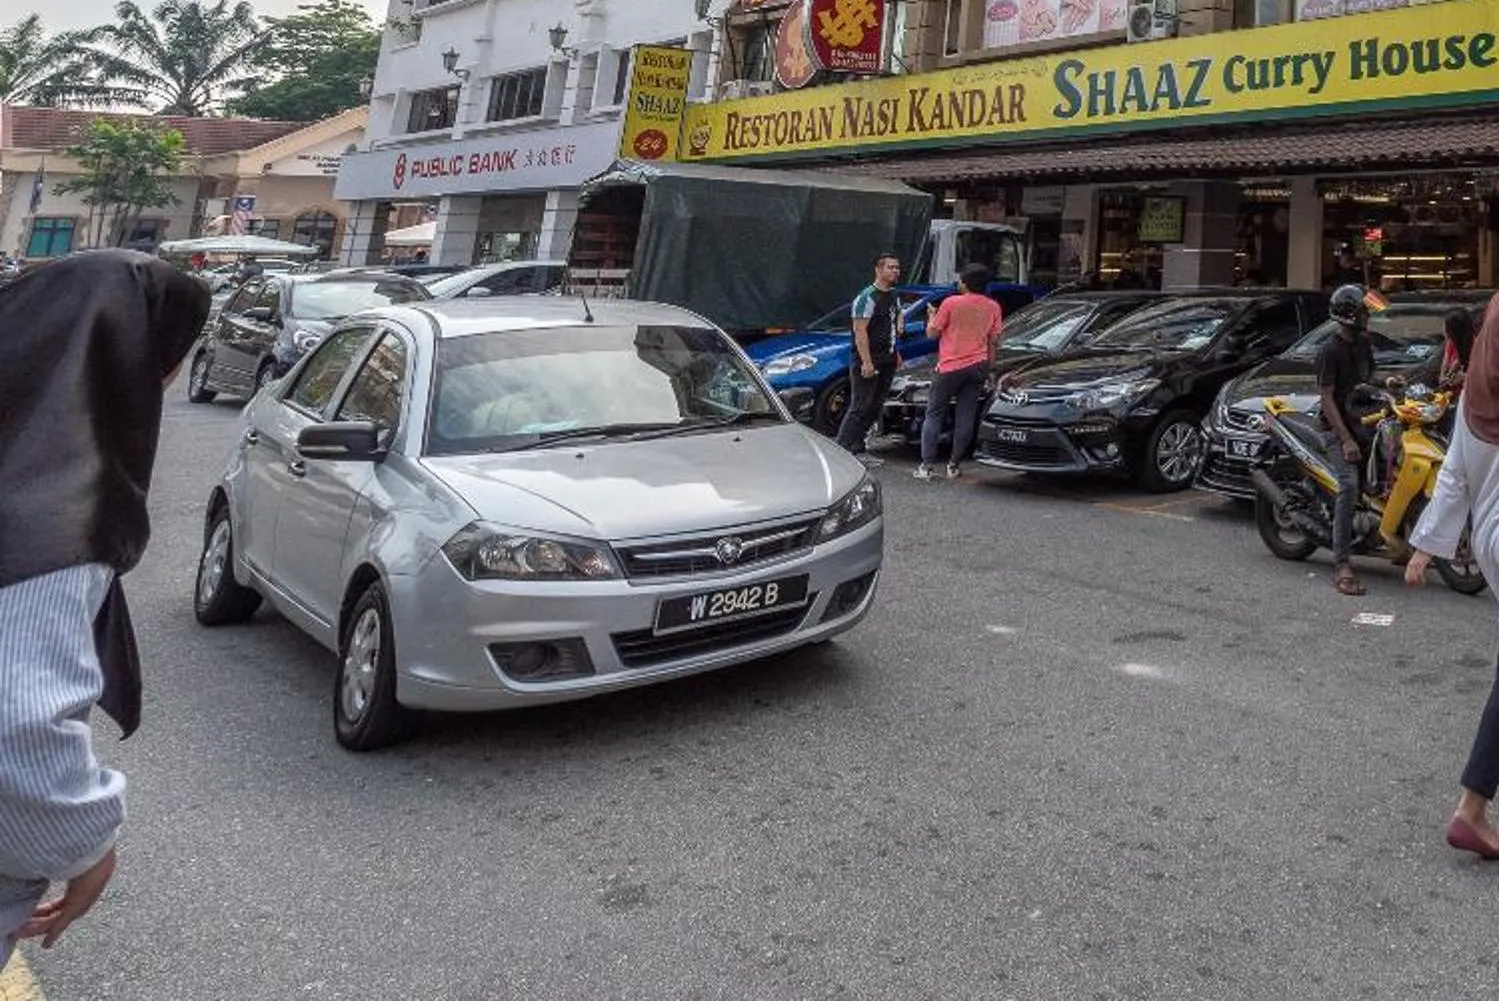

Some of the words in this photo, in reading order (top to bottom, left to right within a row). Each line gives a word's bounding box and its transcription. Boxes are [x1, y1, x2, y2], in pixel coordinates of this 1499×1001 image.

[723, 105, 836, 150] RESTORAN
[839, 96, 901, 139] NASI
[906, 83, 1027, 133] KANDAR
[1053, 58, 1213, 119] SHAAZ
[1223, 51, 1336, 94] Curry
[1349, 32, 1498, 80] House
[411, 153, 464, 178] PUBLIC
[468, 148, 518, 174] BANK
[690, 595, 708, 621] W
[765, 582, 779, 605] B
